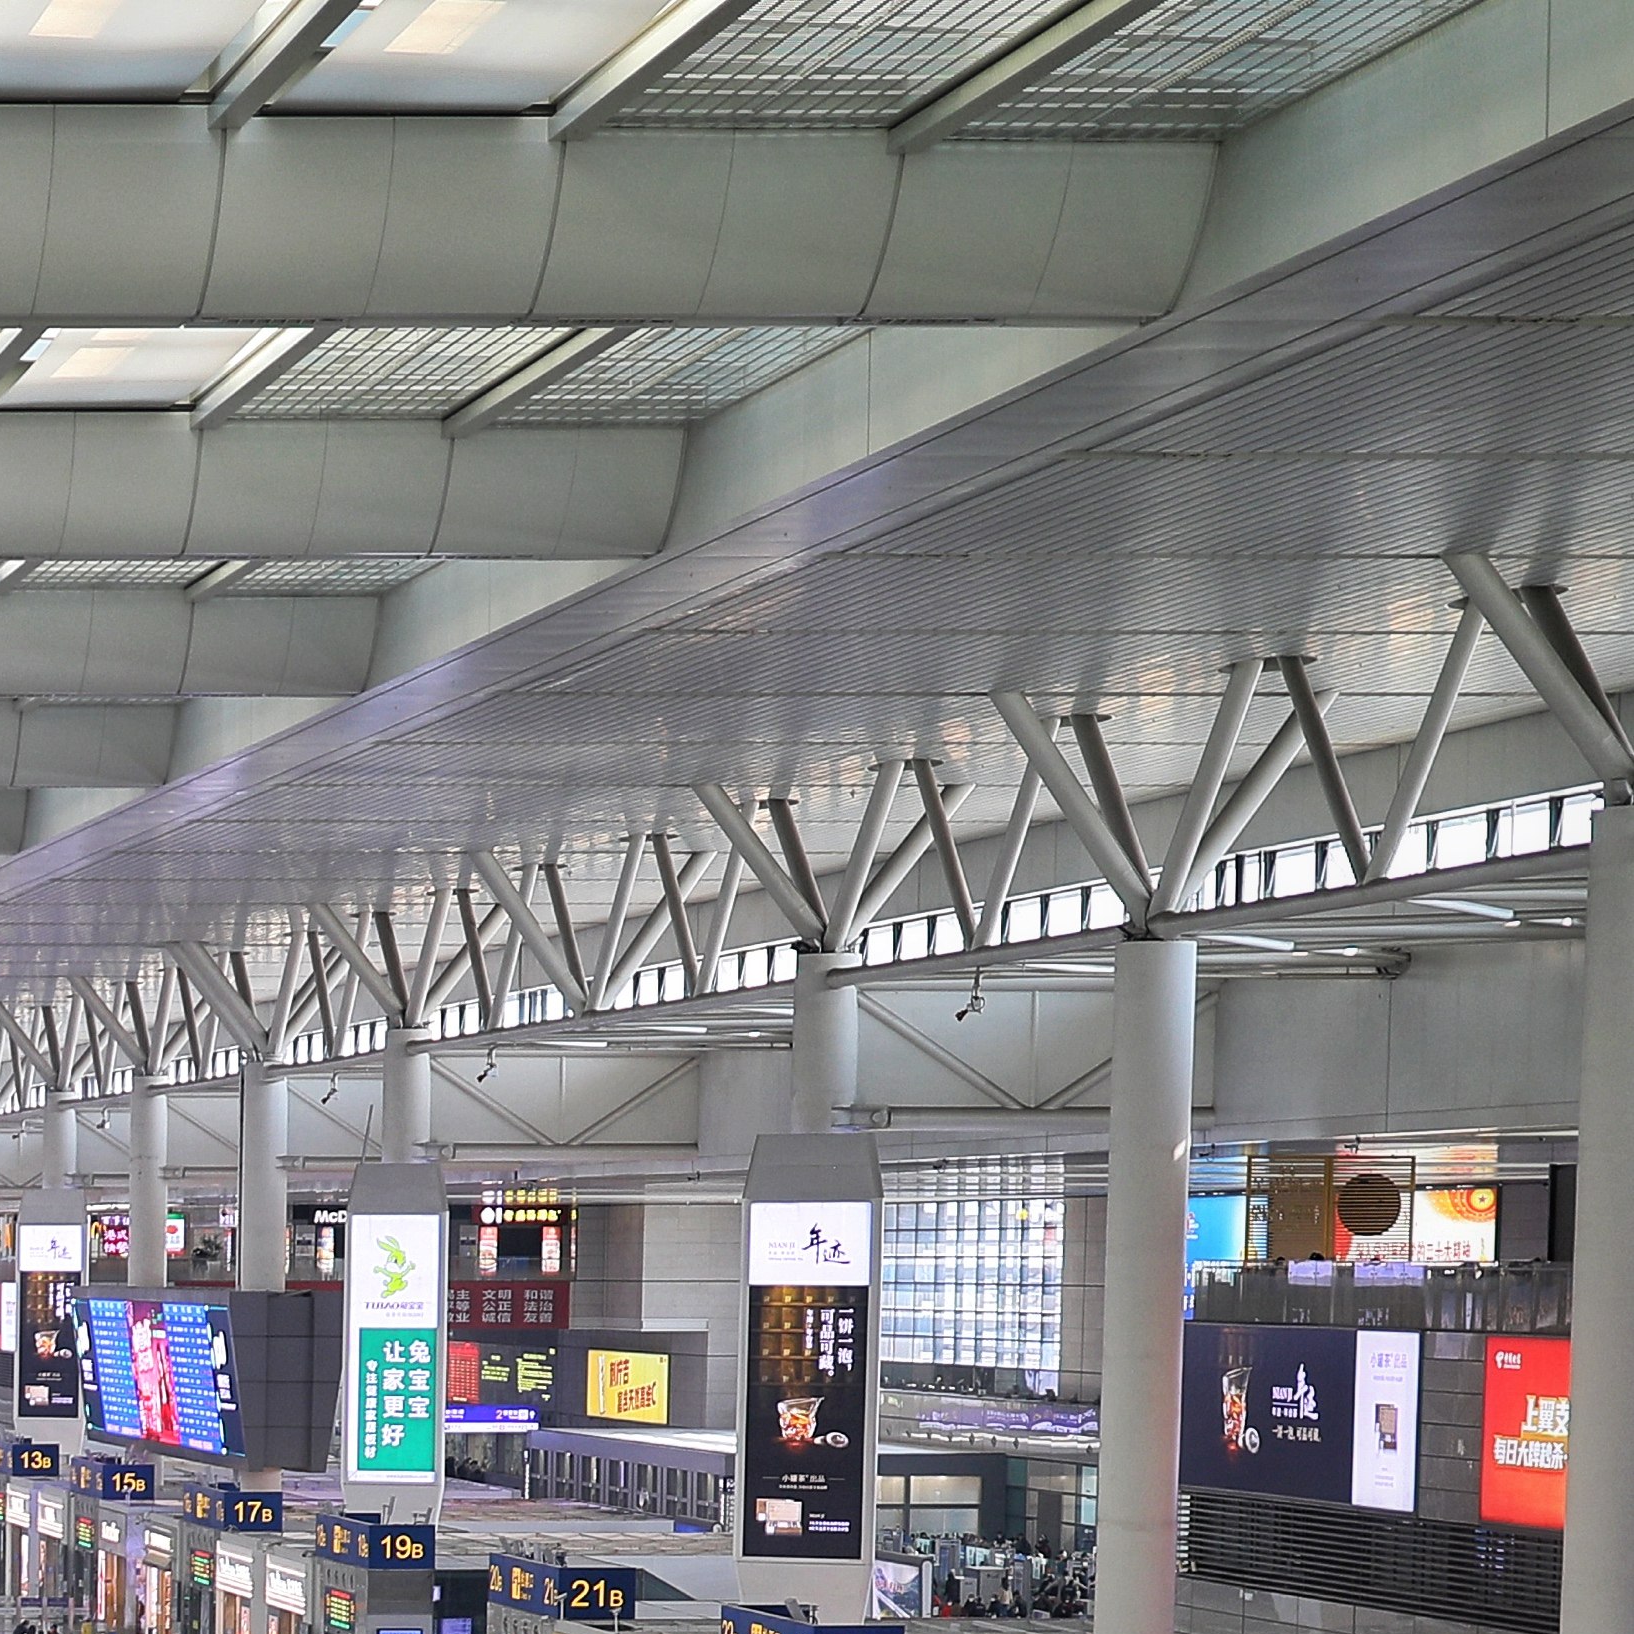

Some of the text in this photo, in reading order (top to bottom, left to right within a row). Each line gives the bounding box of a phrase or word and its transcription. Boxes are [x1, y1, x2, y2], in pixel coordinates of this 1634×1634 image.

[482, 1289, 554, 1300] 文明 和谐
[481, 1312, 553, 1323] 诚信 友善
[482, 1301, 553, 1312] 公正 法治
[408, 1340, 431, 1419] 兔宝宝
[382, 1340, 406, 1447] 让家更好
[20, 1451, 52, 1470] 13B
[112, 1472, 146, 1494] 15B
[234, 1501, 273, 1523] 17B
[381, 1535, 424, 1560] 19B
[571, 1579, 624, 1608] 21B
